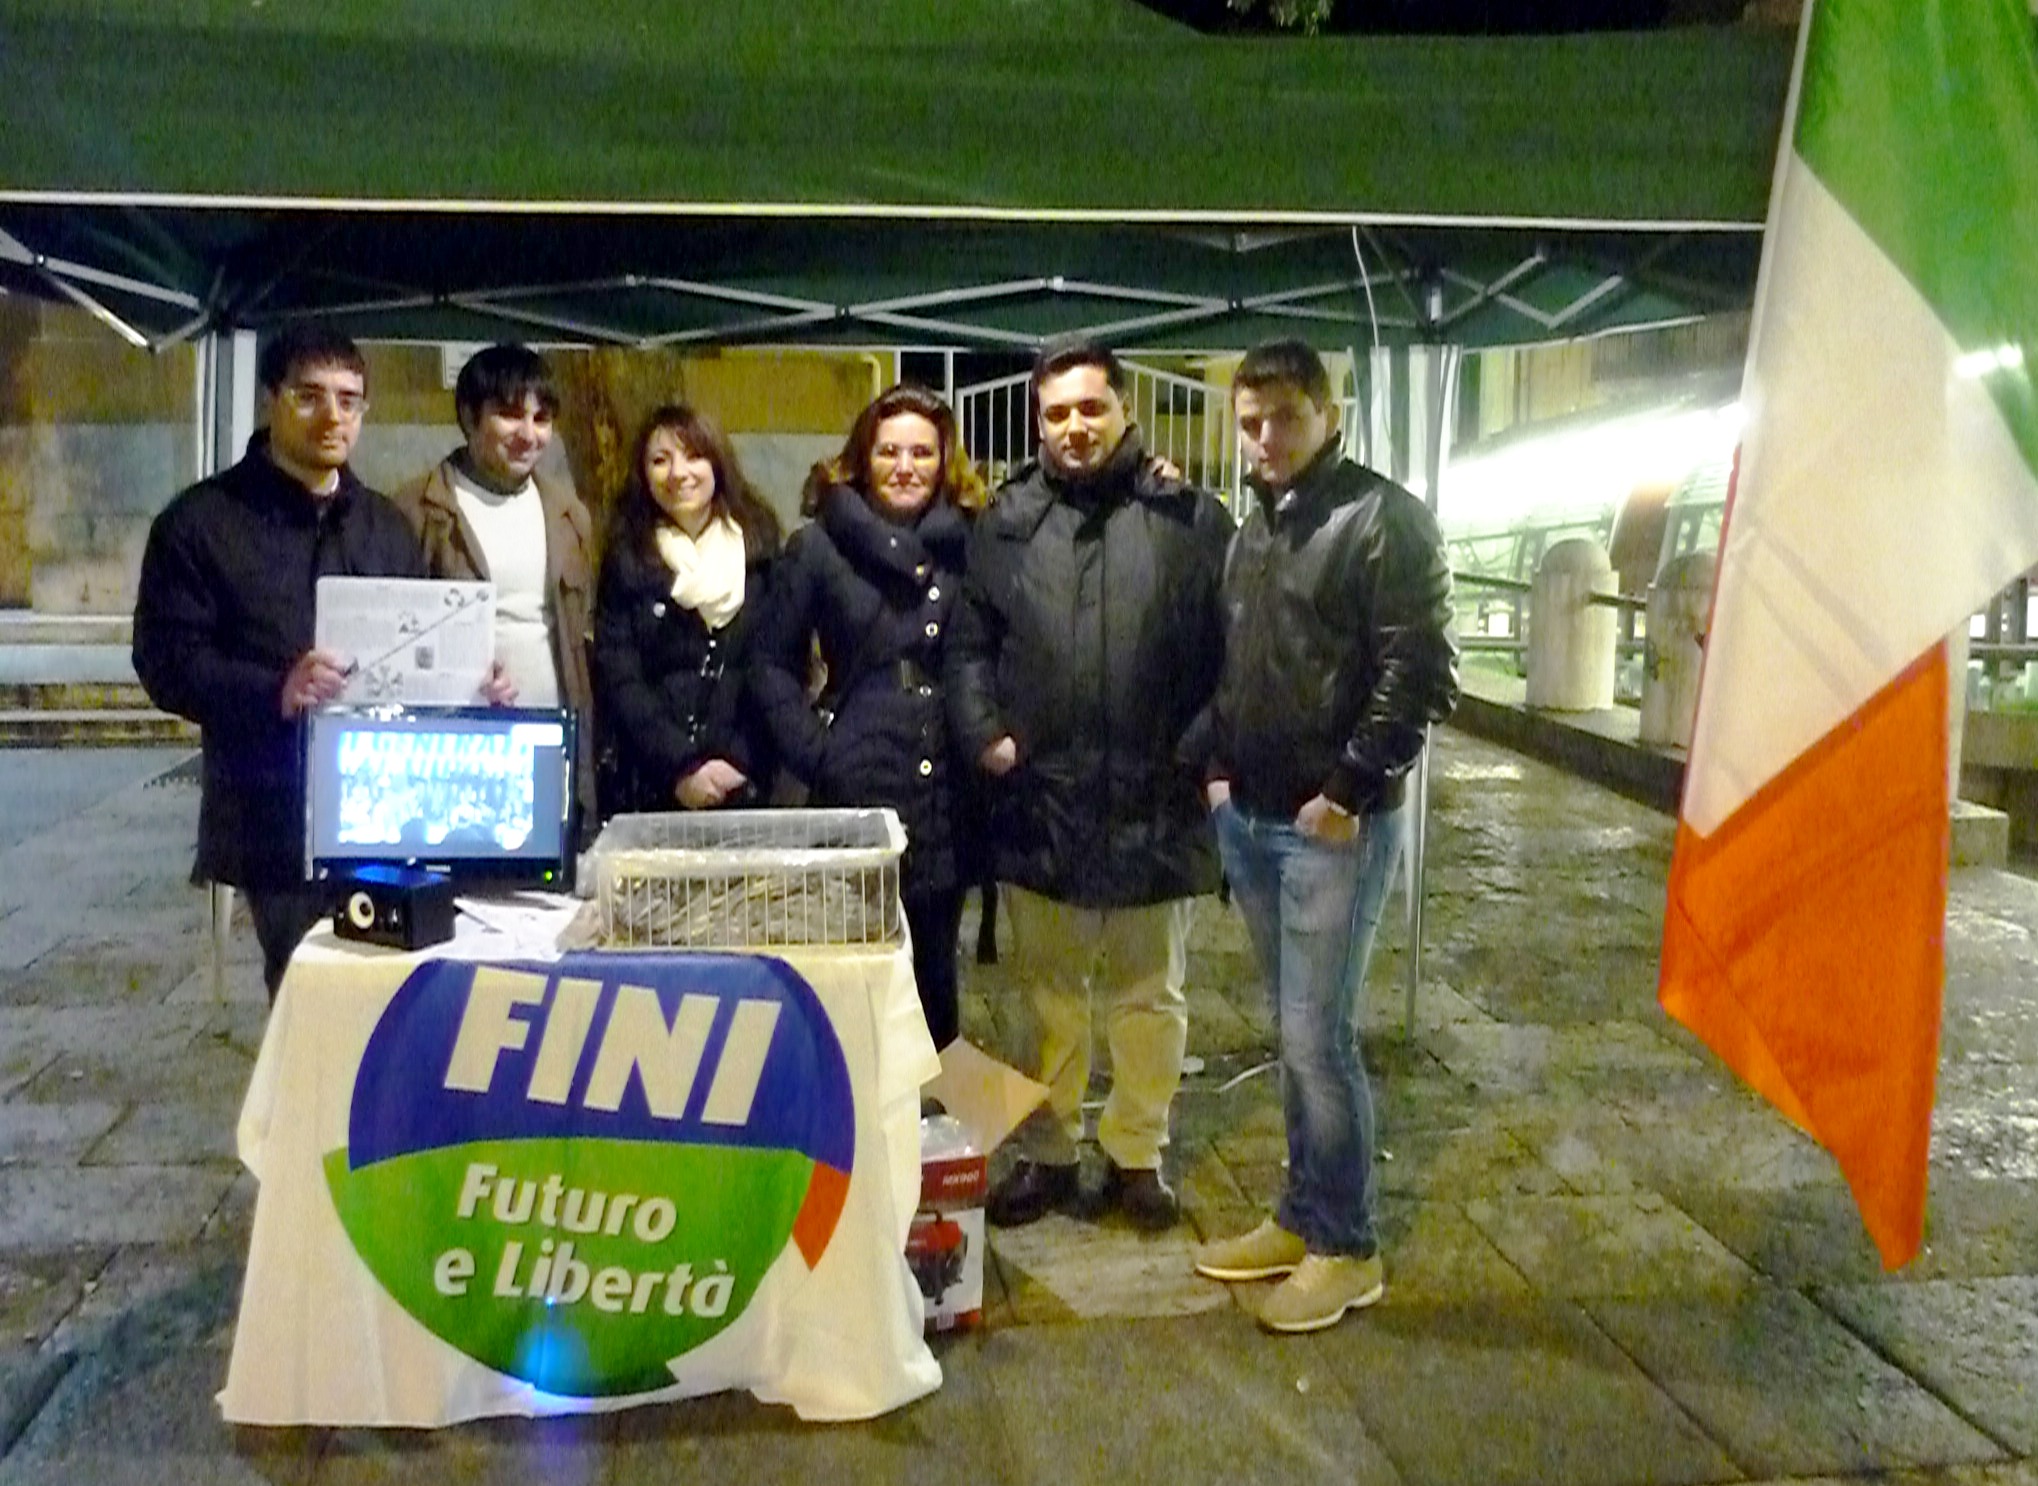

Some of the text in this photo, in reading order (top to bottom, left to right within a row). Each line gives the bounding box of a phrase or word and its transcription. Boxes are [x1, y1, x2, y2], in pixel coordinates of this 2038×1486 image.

[443, 966, 783, 1126] FINI
[457, 1163, 677, 1242] Futuro
[433, 1239, 735, 1319] e Libertà
